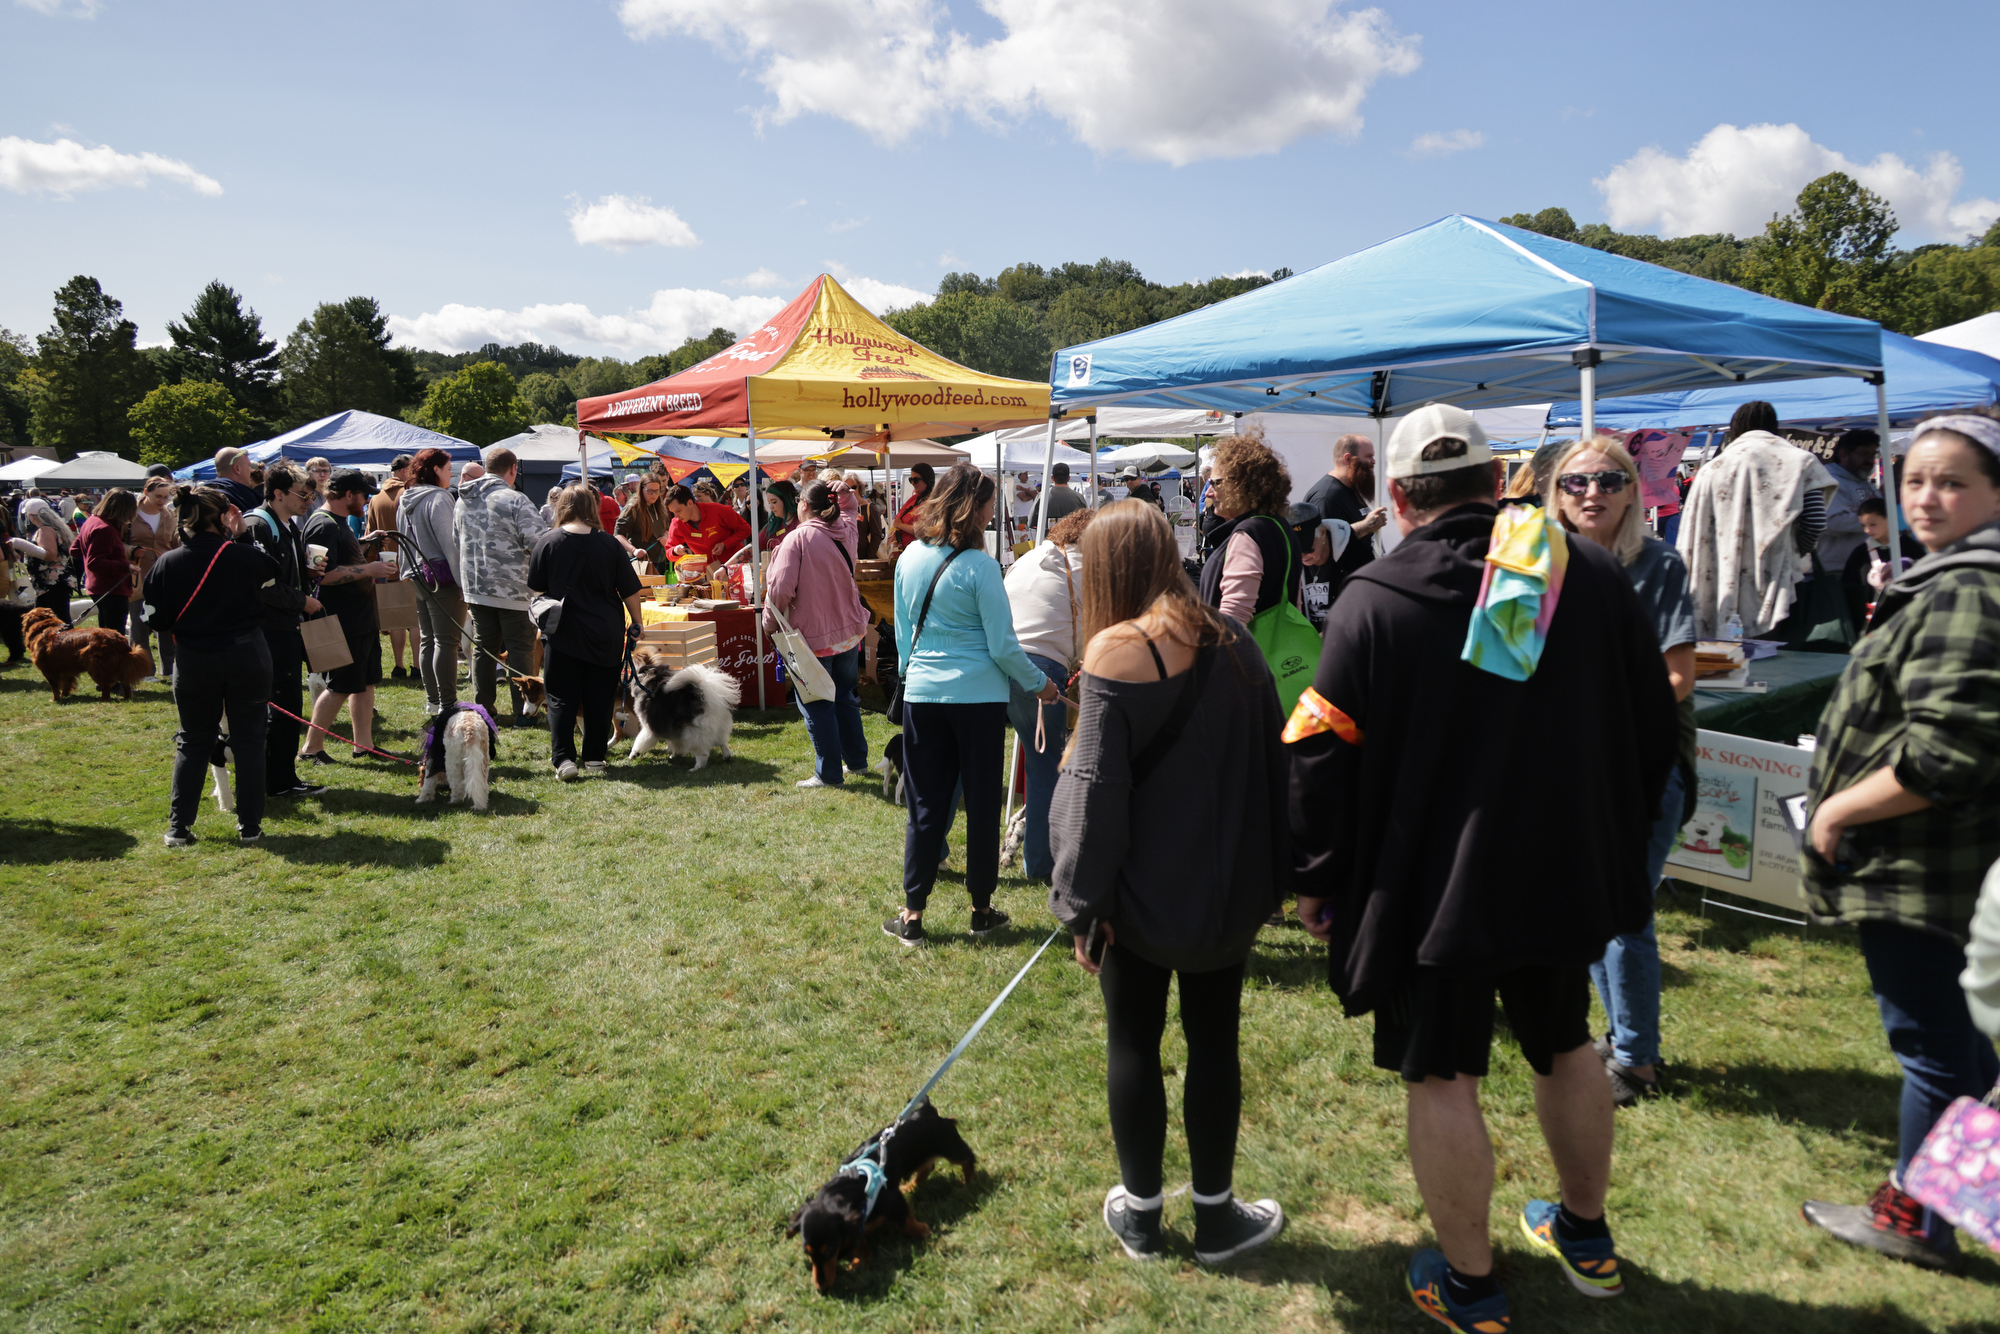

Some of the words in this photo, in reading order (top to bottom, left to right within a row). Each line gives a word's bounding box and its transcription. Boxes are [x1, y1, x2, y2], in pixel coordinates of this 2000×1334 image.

[810, 327, 919, 357] Hollywood
[852, 345, 910, 367] Feed
[603, 403, 613, 418] A
[611, 395, 666, 417] DIFFERENT
[666, 392, 703, 411] BREED
[842, 386, 1028, 412] hollywoodfeed.com
[1822, 436, 1840, 460] g
[722, 635, 737, 648] YOUR
[716, 653, 732, 668] et
[1282, 664, 1309, 679] SUBARU
[1718, 750, 1802, 779] SIGNING
[1698, 784, 1741, 803] SOME
[1763, 789, 1780, 801] Th
[1762, 806, 1783, 818] sto
